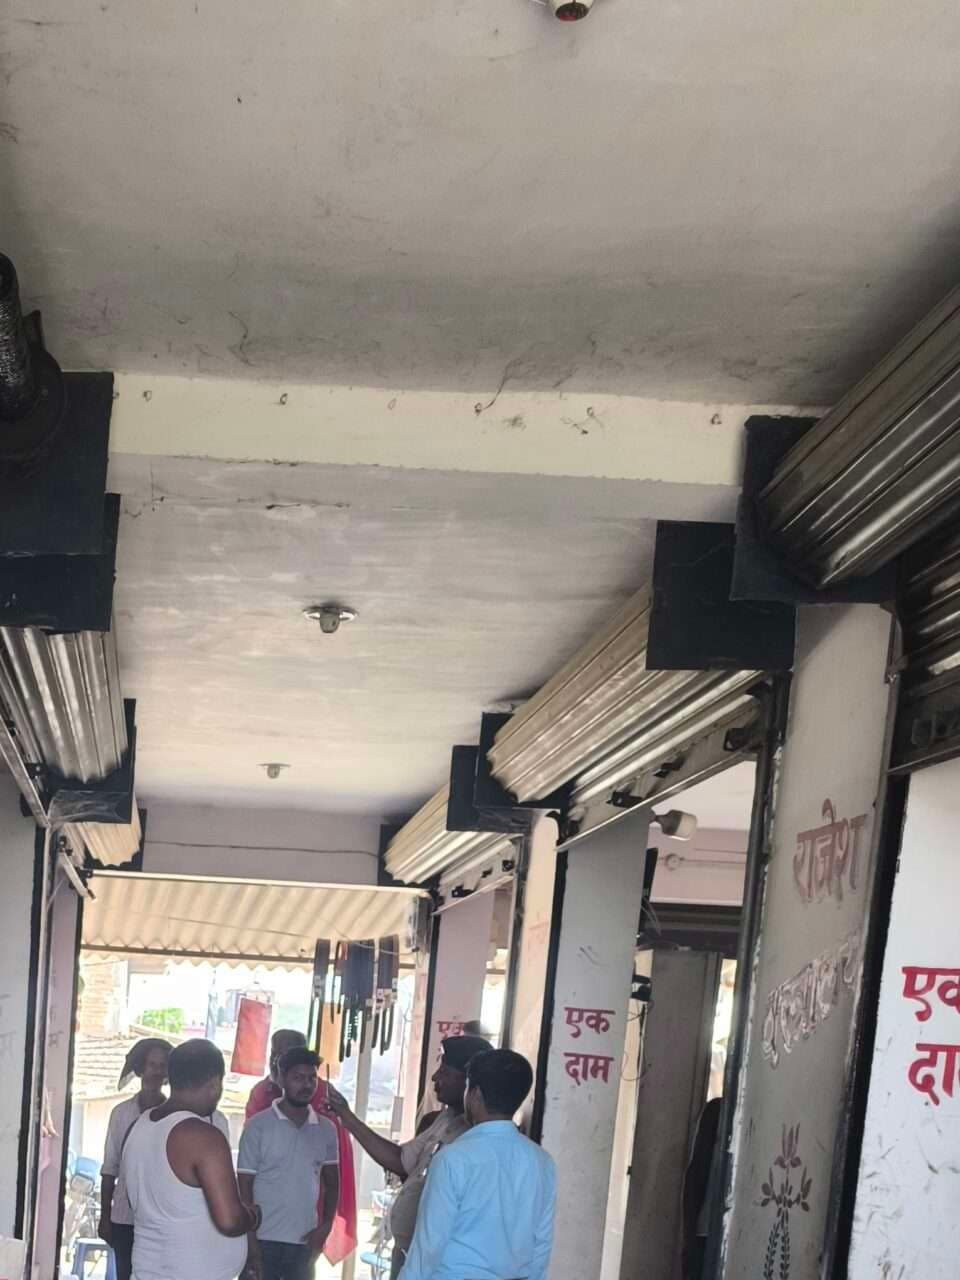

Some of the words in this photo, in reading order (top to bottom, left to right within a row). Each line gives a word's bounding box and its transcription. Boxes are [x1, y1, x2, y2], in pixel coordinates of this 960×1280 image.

[793, 798, 869, 903] राजेश
[564, 1006, 616, 1039] एक
[563, 1051, 615, 1086] दाम
